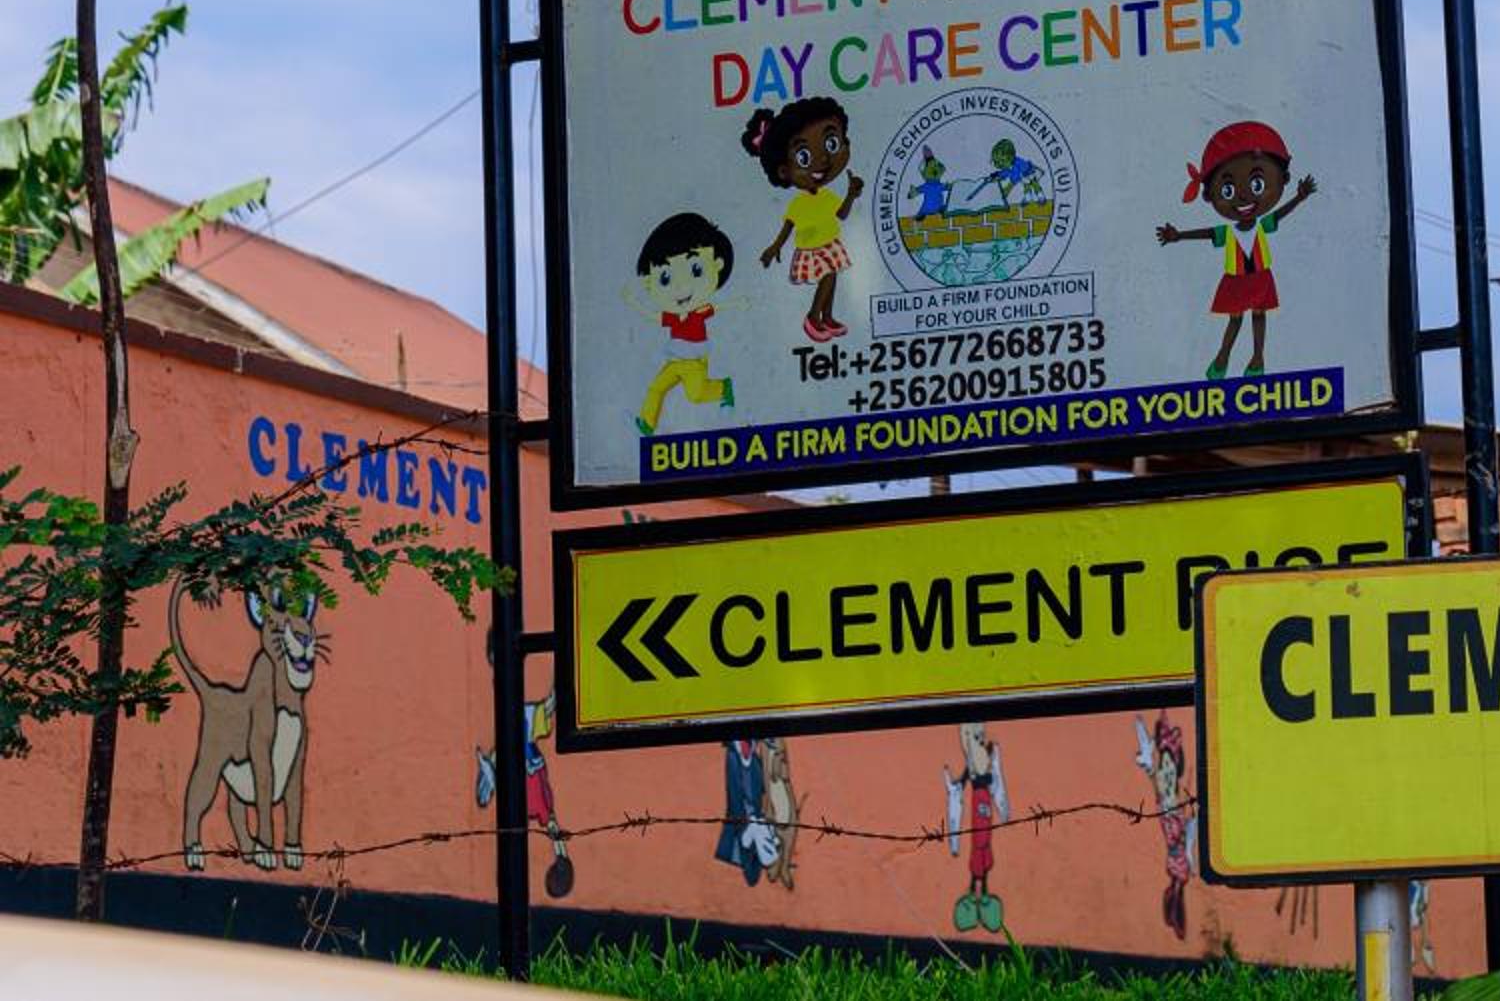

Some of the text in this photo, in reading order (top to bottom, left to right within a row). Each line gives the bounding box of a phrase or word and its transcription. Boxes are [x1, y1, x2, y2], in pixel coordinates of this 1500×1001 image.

[713, 43, 814, 107] DAY
[829, 22, 983, 92] CARE
[881, 96, 1073, 256] CLEMENT SCHOOL INVESTMENTS (U) LTD
[877, 278, 1090, 314] BUILD A FIRM FOUNDATION
[915, 302, 1050, 329] FOR YOUR CHILD
[652, 377, 1333, 472] BUILD A FIRM FOUNDATION FOR YOUR CHILD
[848, 357, 1107, 413] +256200915805
[248, 415, 487, 525] CLEMENT
[709, 560, 1145, 667] CLEMENT
